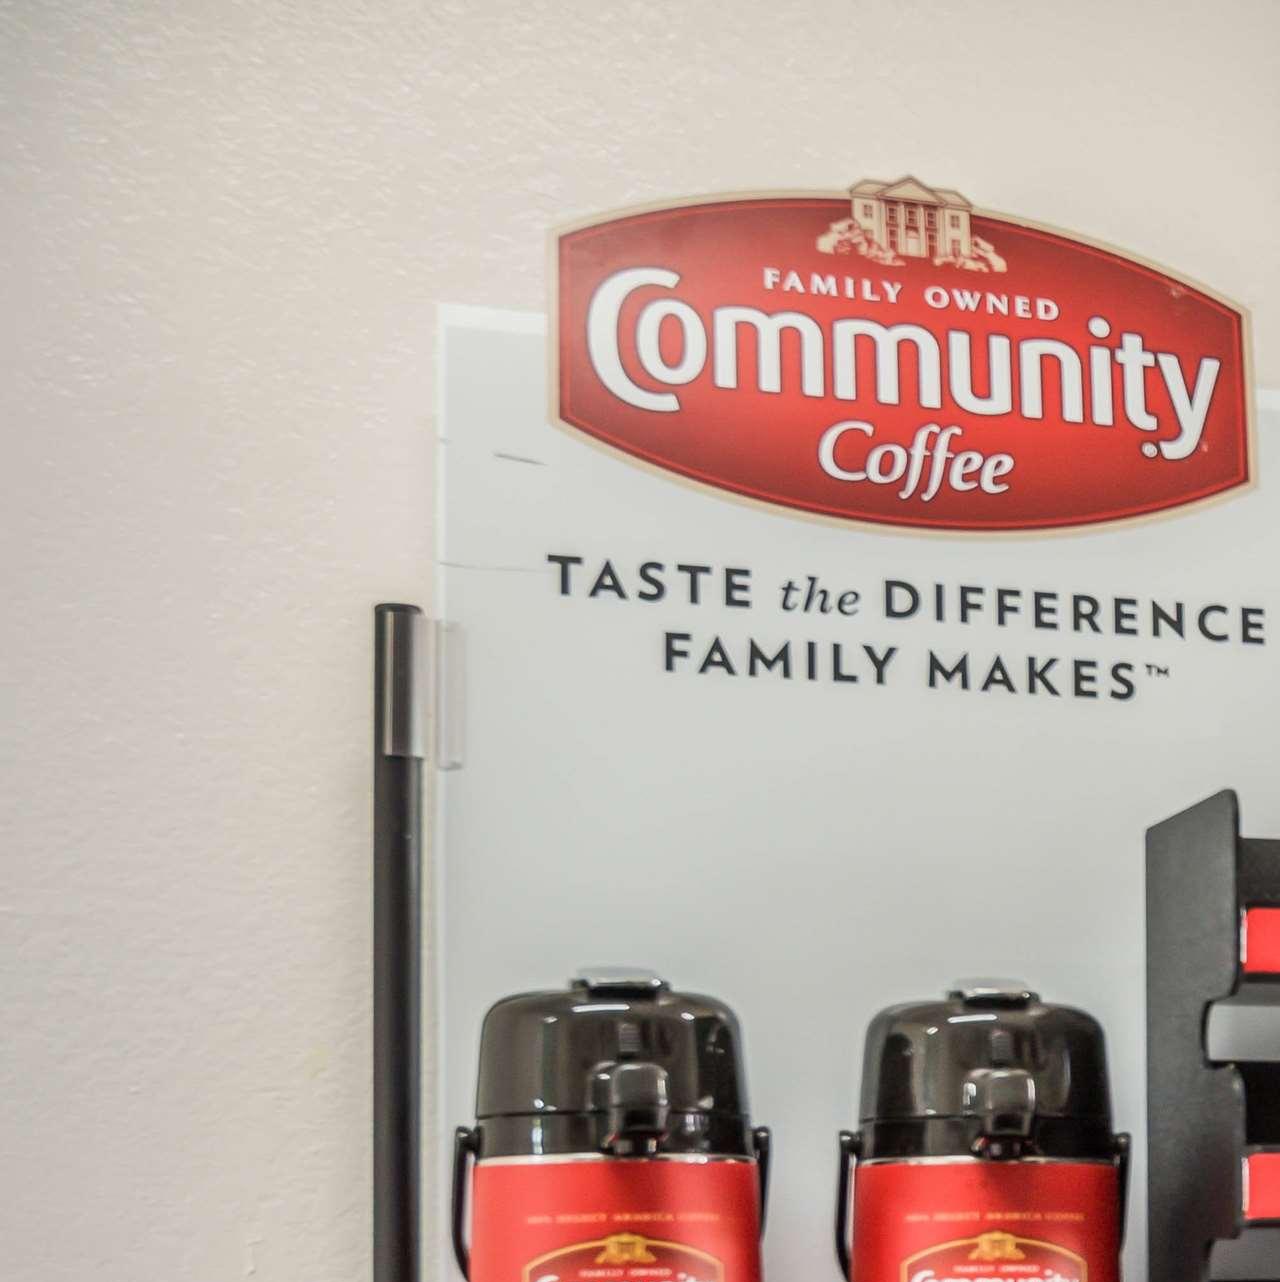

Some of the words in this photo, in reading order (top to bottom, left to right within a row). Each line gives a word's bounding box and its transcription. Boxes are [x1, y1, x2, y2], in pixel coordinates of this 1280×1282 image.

[763, 268, 903, 304] FAMILY
[924, 286, 1059, 321] OWNED
[586, 267, 1220, 461] Community
[817, 421, 1014, 502] Coffee
[547, 554, 754, 608] TASTE
[779, 576, 861, 617] the
[885, 580, 1267, 645] DIFFERENCE
[663, 632, 899, 686] FAMILY
